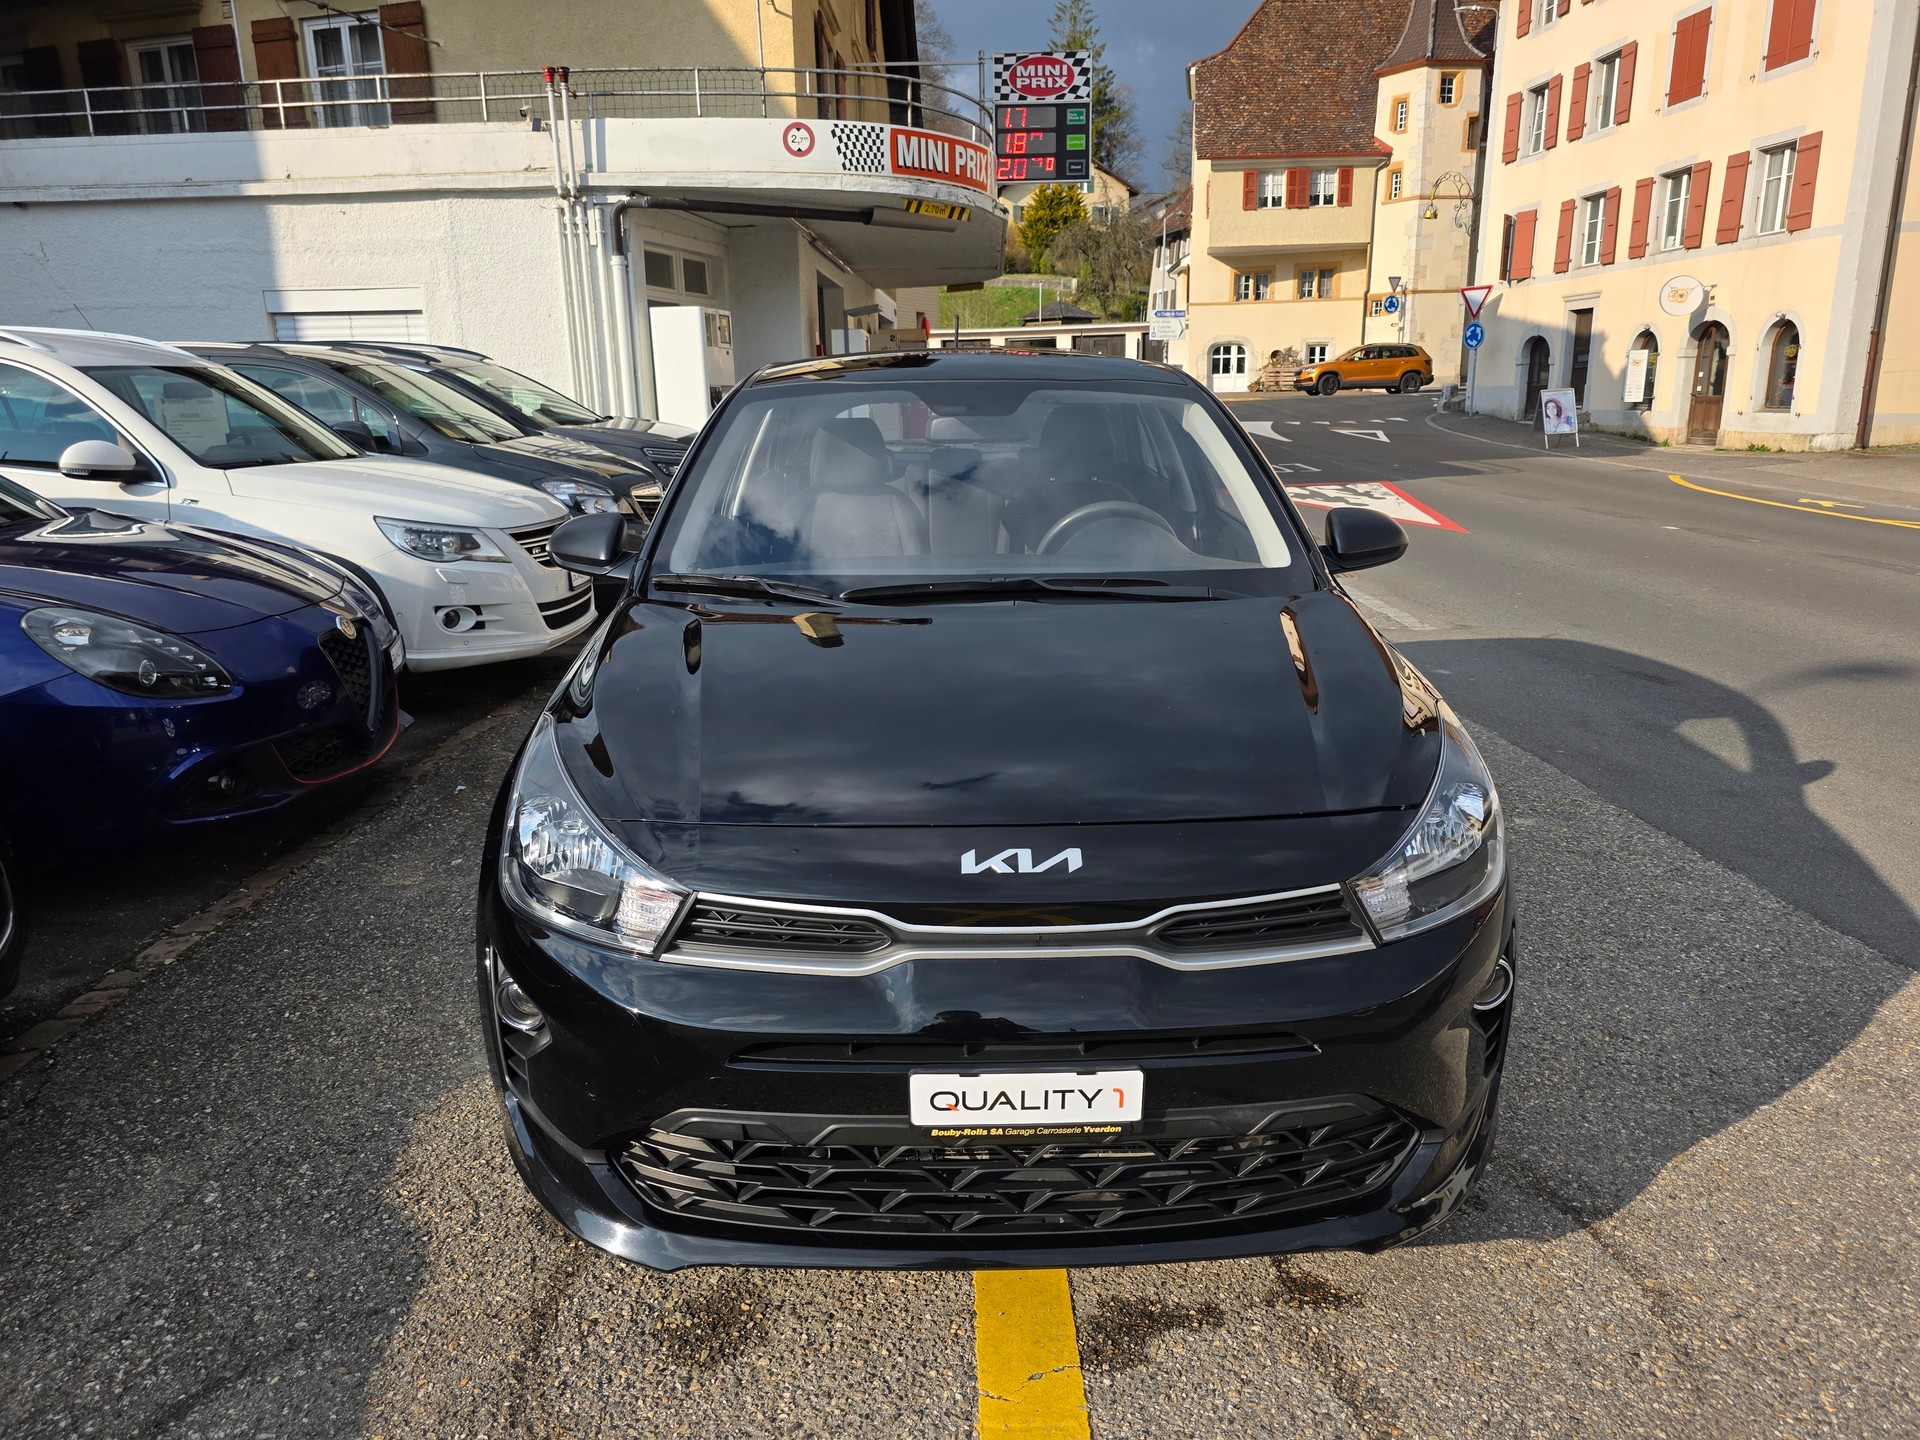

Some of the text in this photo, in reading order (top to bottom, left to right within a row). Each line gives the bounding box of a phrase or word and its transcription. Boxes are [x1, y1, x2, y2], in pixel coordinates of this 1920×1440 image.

[1016, 64, 1068, 77] MINI
[1016, 76, 1069, 89] PRIX
[897, 134, 987, 185] MINI PRIX
[961, 847, 1083, 875] KIA
[930, 1087, 1125, 1112] QUALITY 1
[931, 1125, 1122, 1137] Bouby-Rolls SA Garage Carrosserie Yverdon
